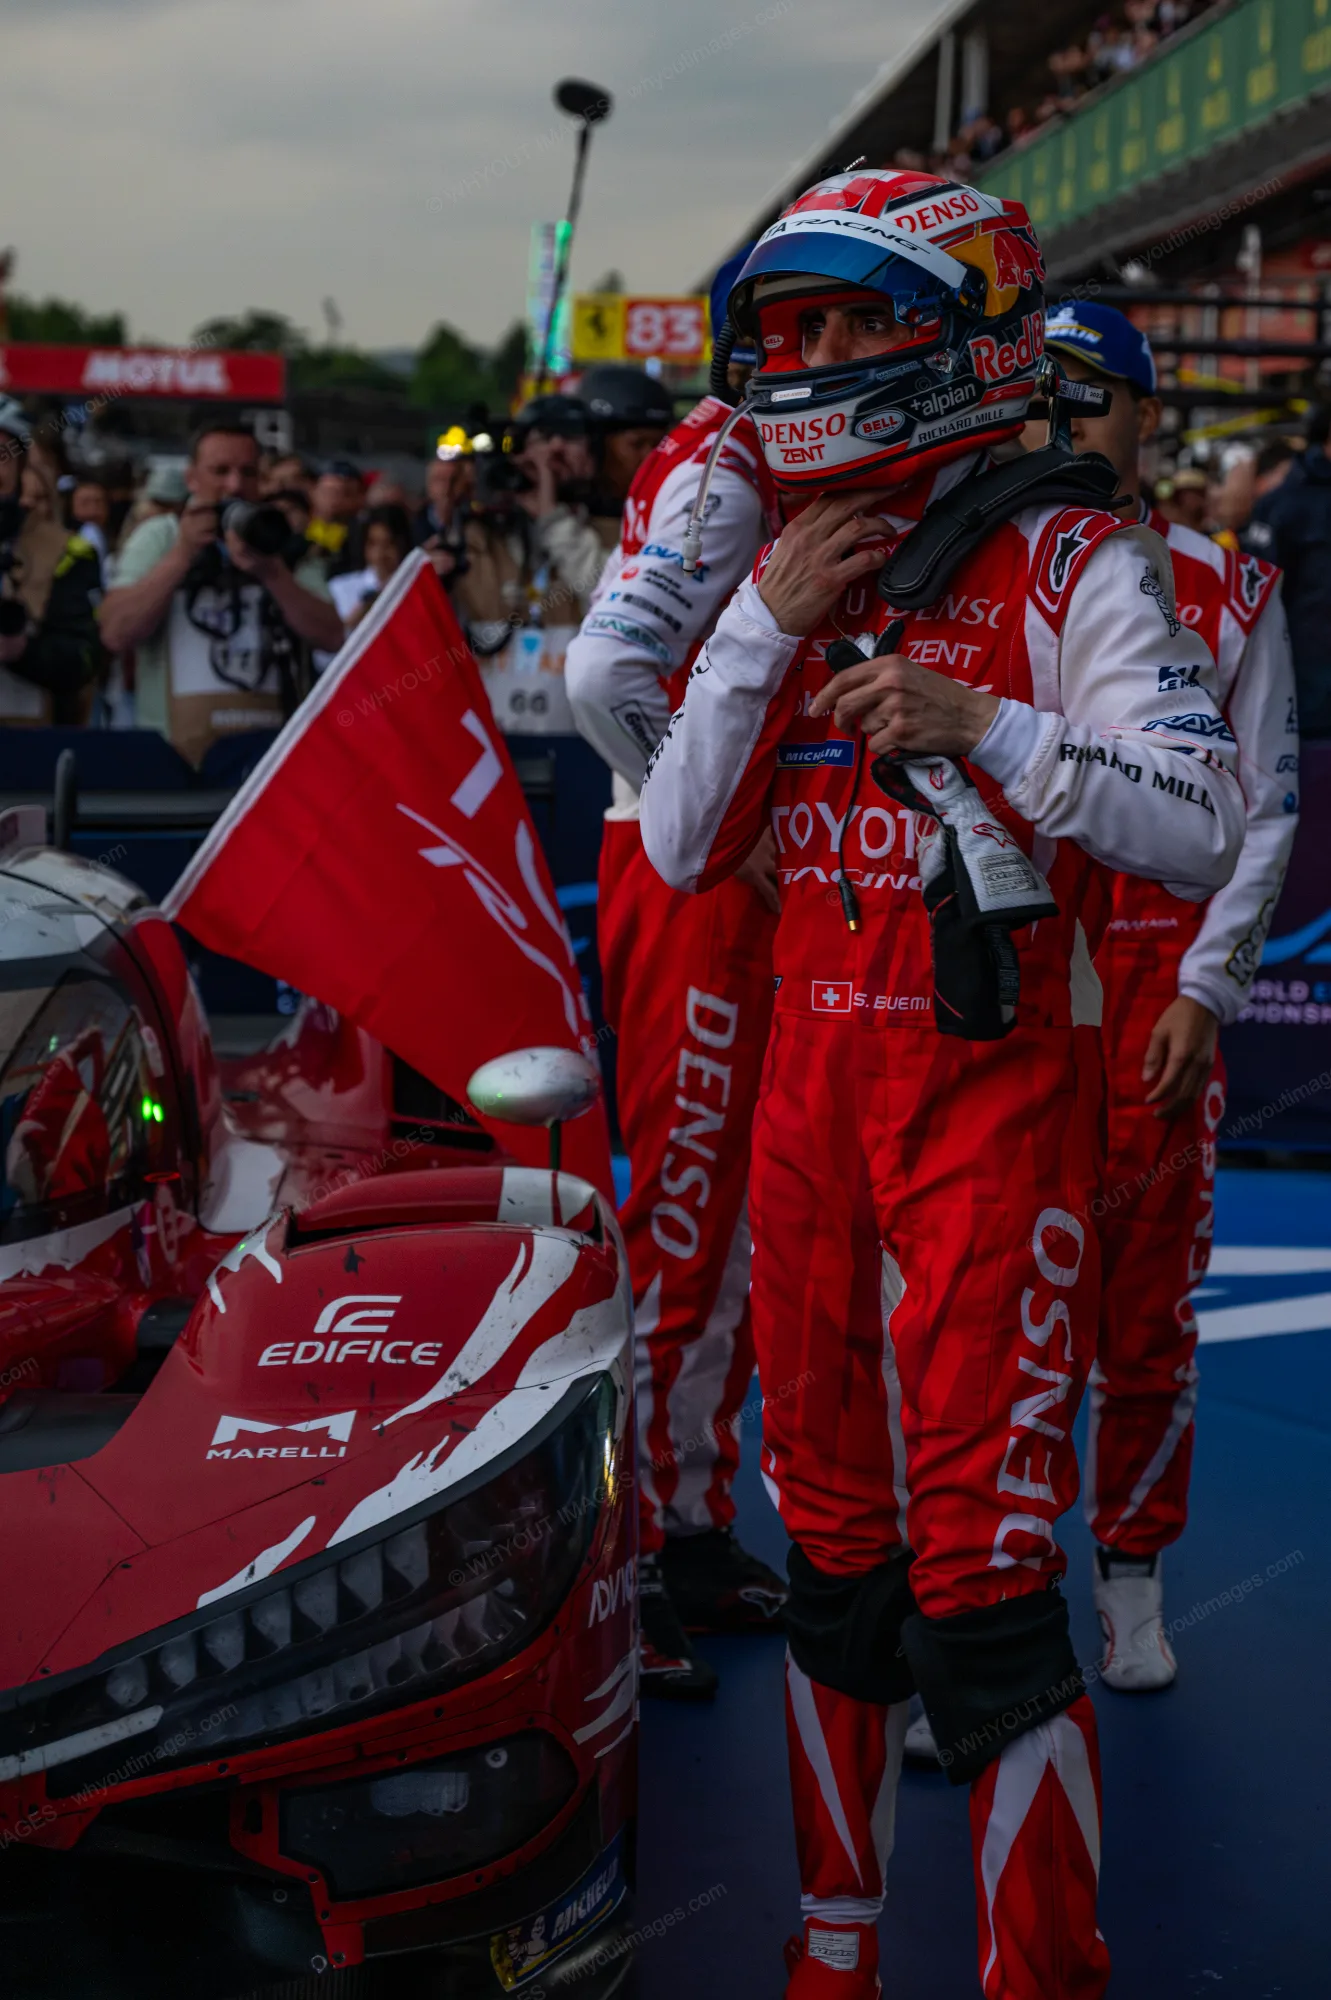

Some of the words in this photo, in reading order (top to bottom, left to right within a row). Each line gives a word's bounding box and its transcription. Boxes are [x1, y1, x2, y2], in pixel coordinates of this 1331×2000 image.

[894, 193, 979, 234] DENSO
[790, 218, 931, 254] RACING
[625, 302, 704, 354] 83
[761, 412, 846, 444] DENSO
[862, 415, 899, 434] BELL
[918, 416, 972, 443] RICHARD
[975, 408, 1004, 428] MILLE
[780, 443, 826, 464] ZENT
[885, 594, 1006, 629] NSO
[907, 639, 982, 669] ZENT
[1152, 770, 1216, 816] MILL
[770, 801, 916, 860] TOYOT
[853, 992, 869, 1008] S.
[873, 995, 932, 1011] BUEMI
[648, 984, 741, 1261] DENSO
[257, 1339, 444, 1367] EDIFICE
[988, 1206, 1086, 1571] DENSO
[205, 1446, 348, 1460] MARELLI
